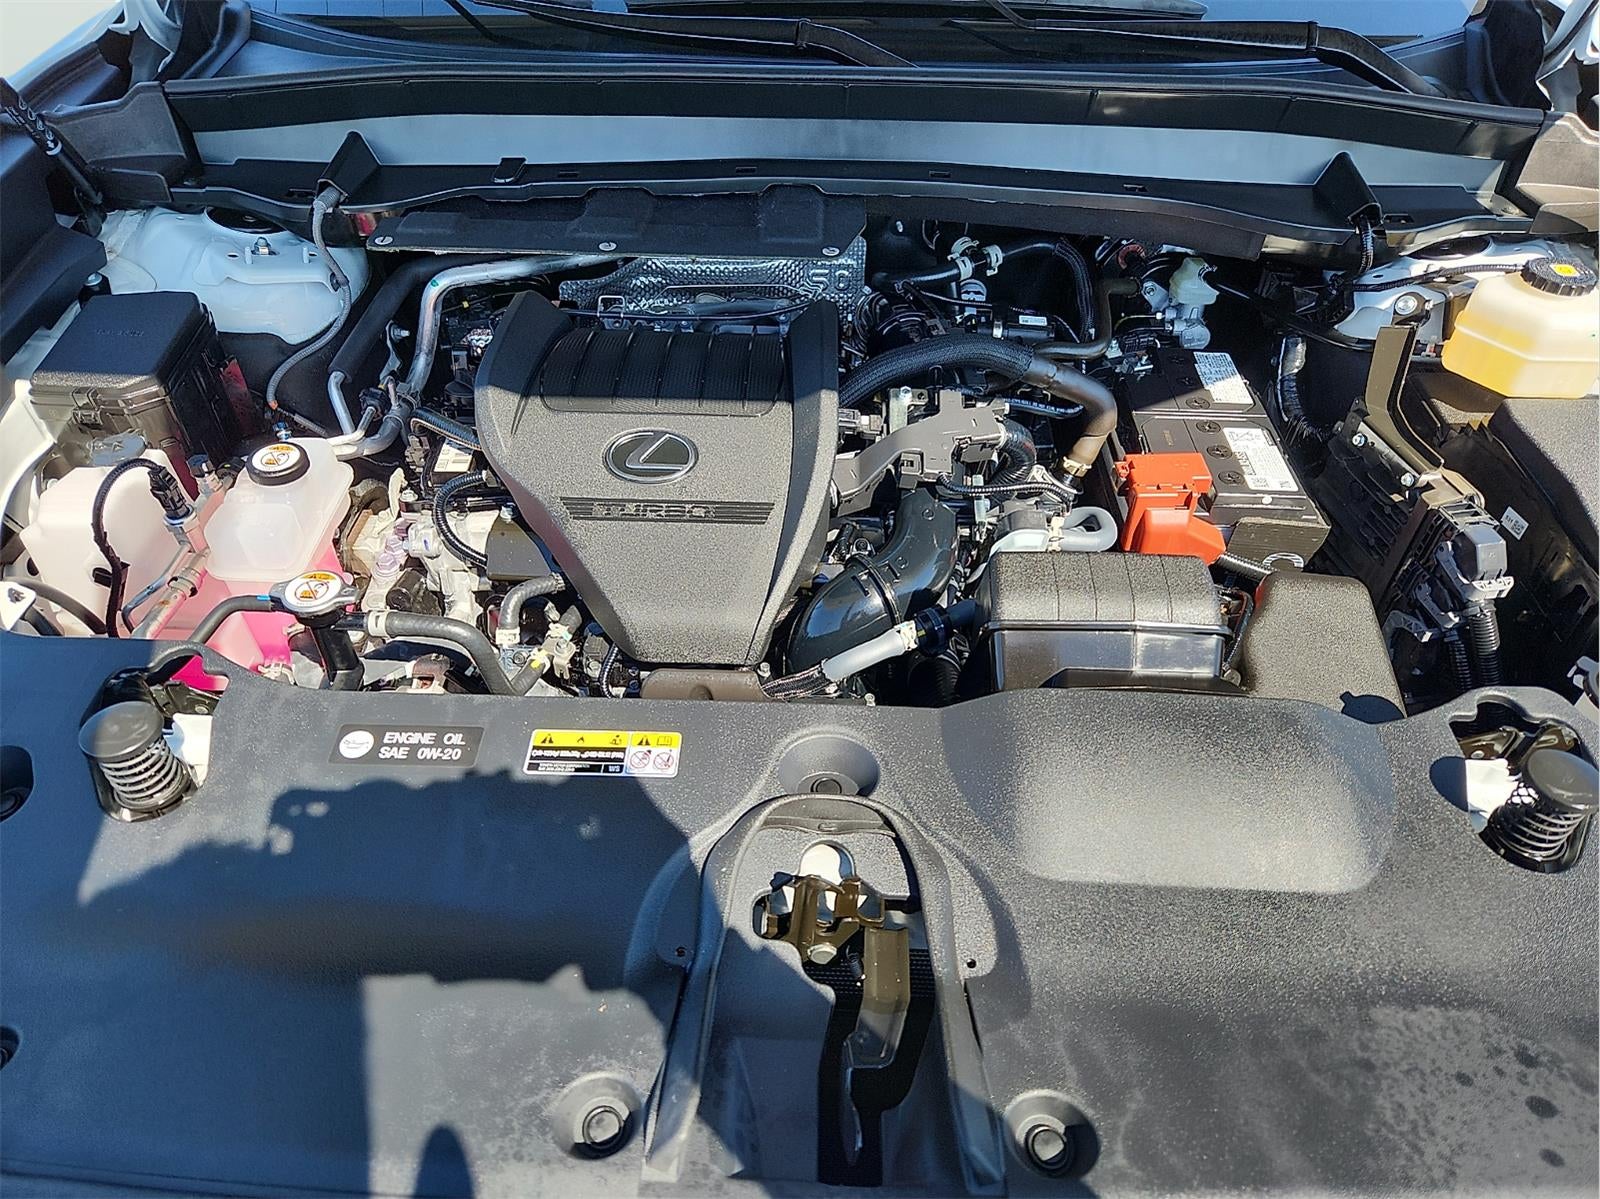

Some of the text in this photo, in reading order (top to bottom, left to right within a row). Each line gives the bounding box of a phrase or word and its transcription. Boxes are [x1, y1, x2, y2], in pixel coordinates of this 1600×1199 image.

[593, 501, 715, 519] TURBO
[382, 731, 466, 745] ENGINE OIL
[378, 746, 462, 760] SAE 0W-20
